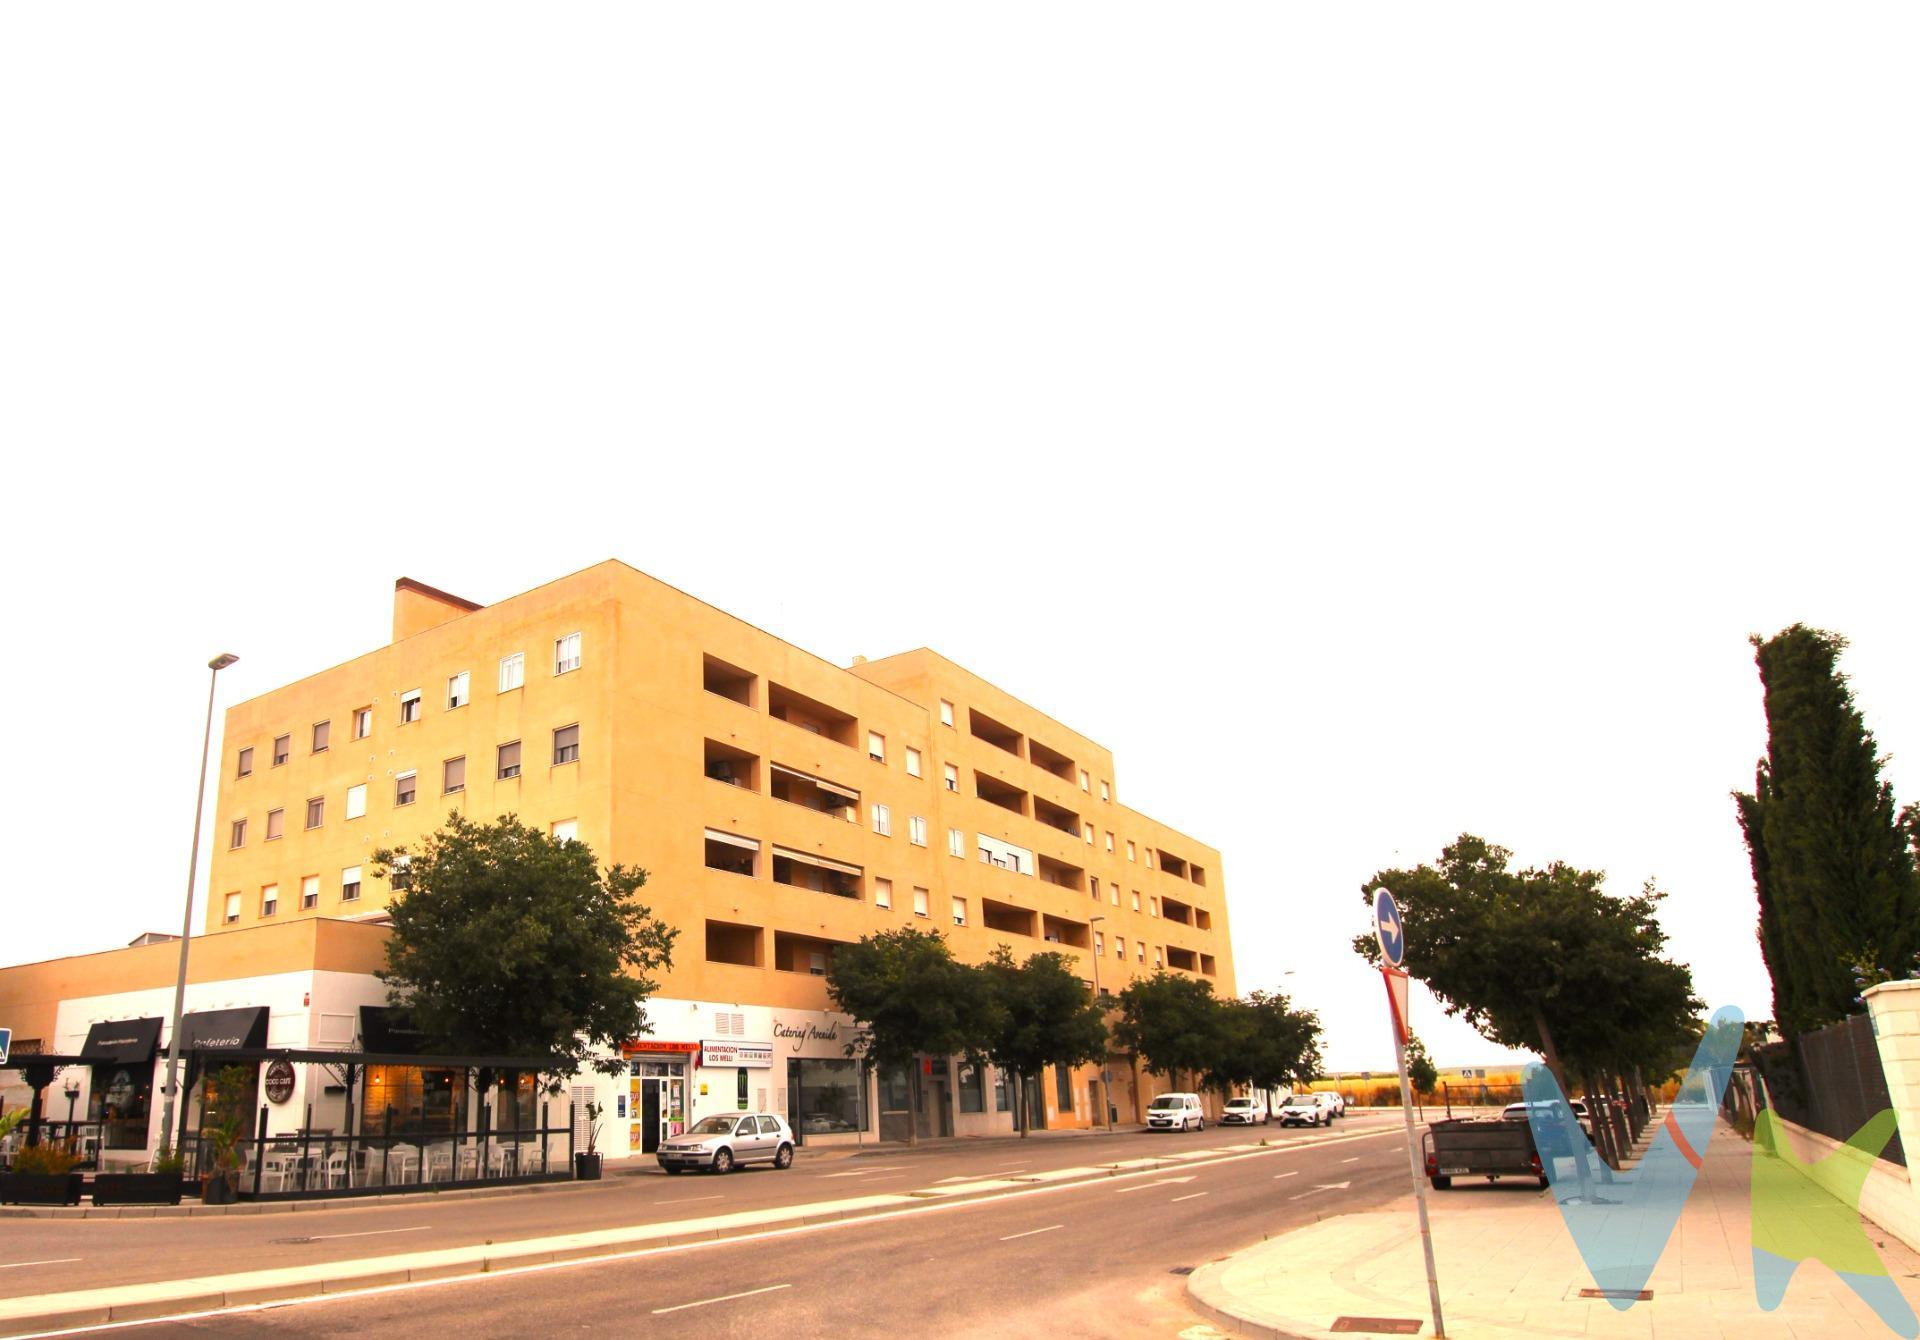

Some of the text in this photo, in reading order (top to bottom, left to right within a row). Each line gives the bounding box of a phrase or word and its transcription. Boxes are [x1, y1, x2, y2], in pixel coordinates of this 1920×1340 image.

[774, 1023, 807, 1052] Catering
[704, 1045, 738, 1053] ALIMENTACION
[709, 1054, 719, 1062] LOS
